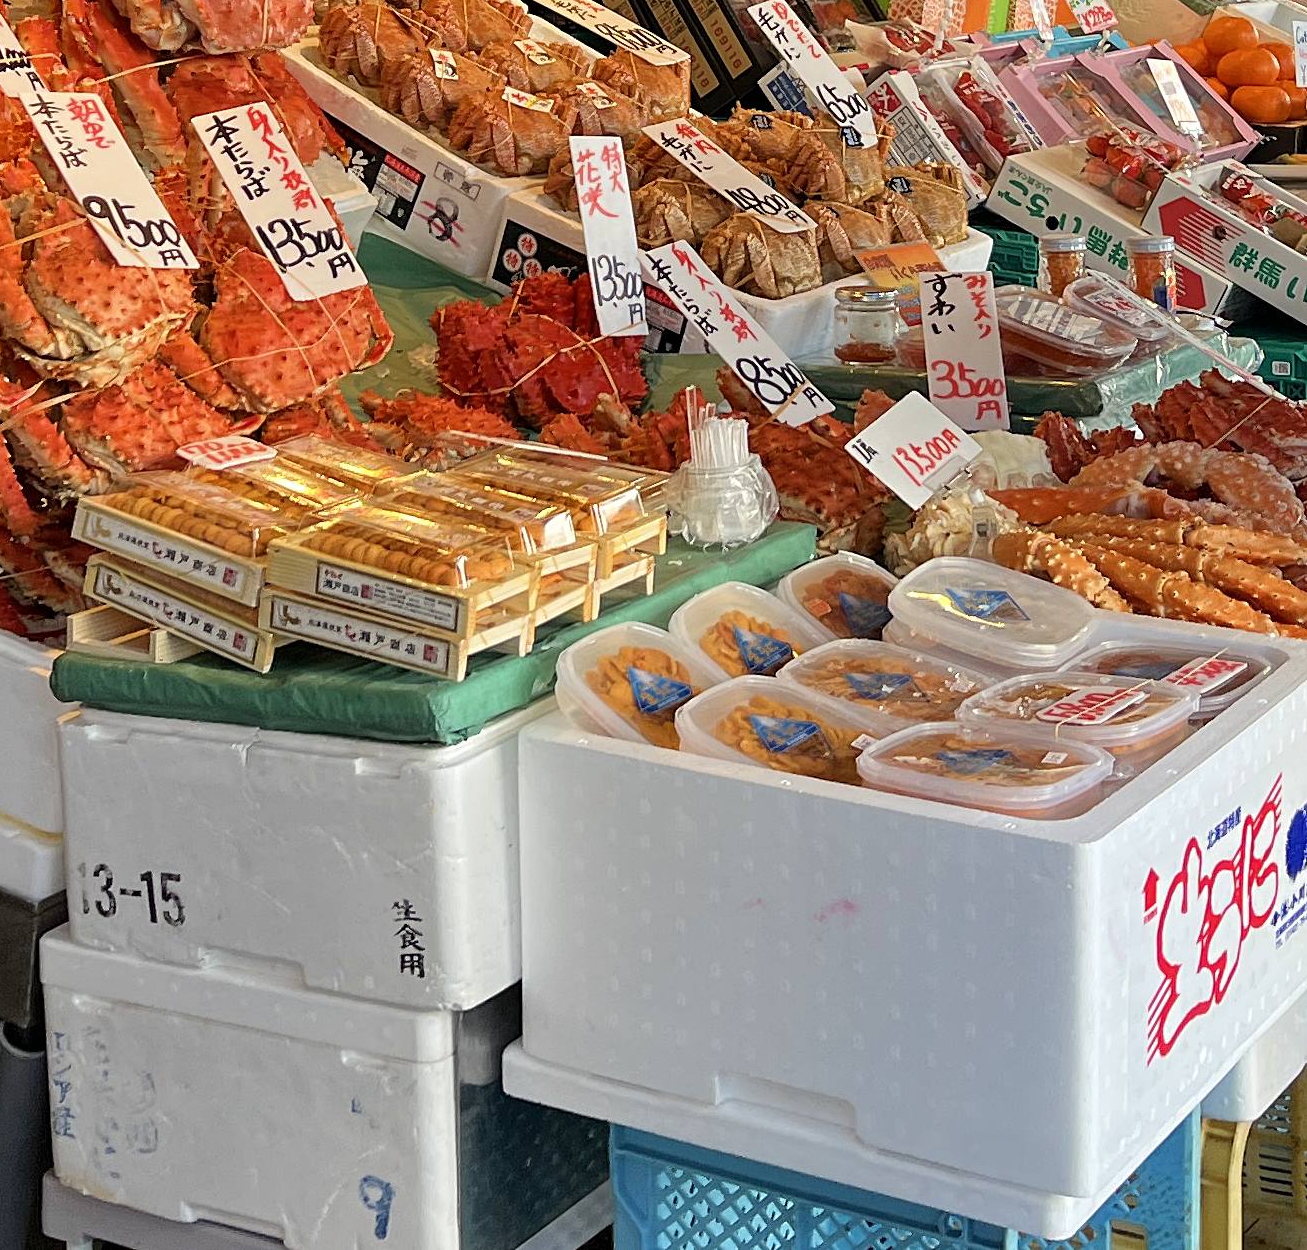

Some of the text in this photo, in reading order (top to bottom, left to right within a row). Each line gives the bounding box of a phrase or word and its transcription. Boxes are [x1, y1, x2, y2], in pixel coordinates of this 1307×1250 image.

[30, 94, 88, 169] 本たらば
[208, 114, 271, 202] 本たらば
[575, 152, 618, 220] 花咲
[600, 141, 626, 194] 特大
[923, 272, 963, 335] すわい
[974, 401, 1003, 422] 円
[75, 862, 187, 927] 13-15
[392, 898, 427, 979] 生食用
